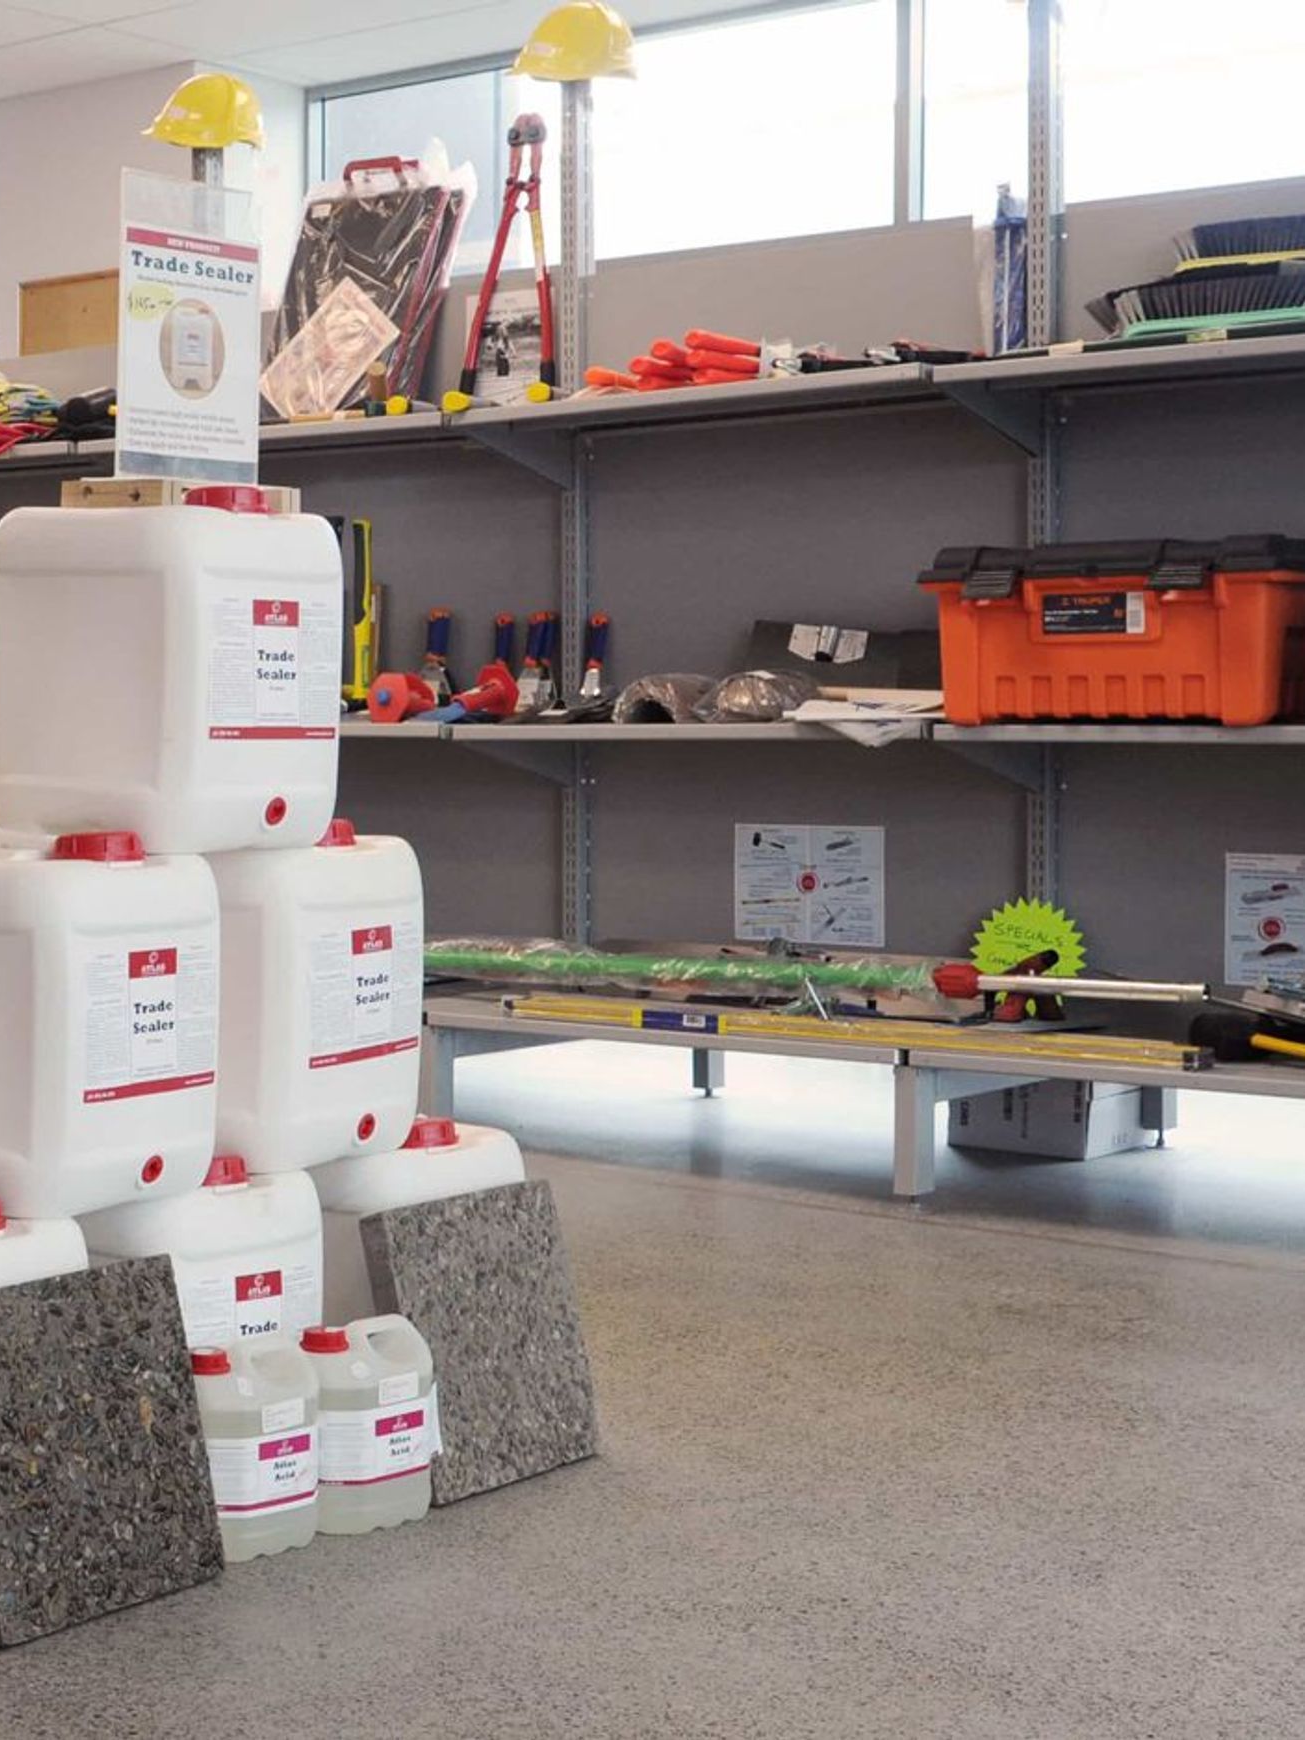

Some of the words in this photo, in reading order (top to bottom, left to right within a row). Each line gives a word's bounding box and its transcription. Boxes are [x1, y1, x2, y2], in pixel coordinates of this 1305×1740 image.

[131, 249, 190, 275] Trade
[194, 259, 255, 285] Sealer
[257, 649, 295, 662] Trade
[256, 668, 297, 681] Sealer
[356, 973, 390, 988] Trade
[355, 991, 391, 1006] Sealer
[133, 1000, 174, 1015] Trade
[132, 1020, 175, 1035] Sealer
[239, 1320, 279, 1336] Trade
